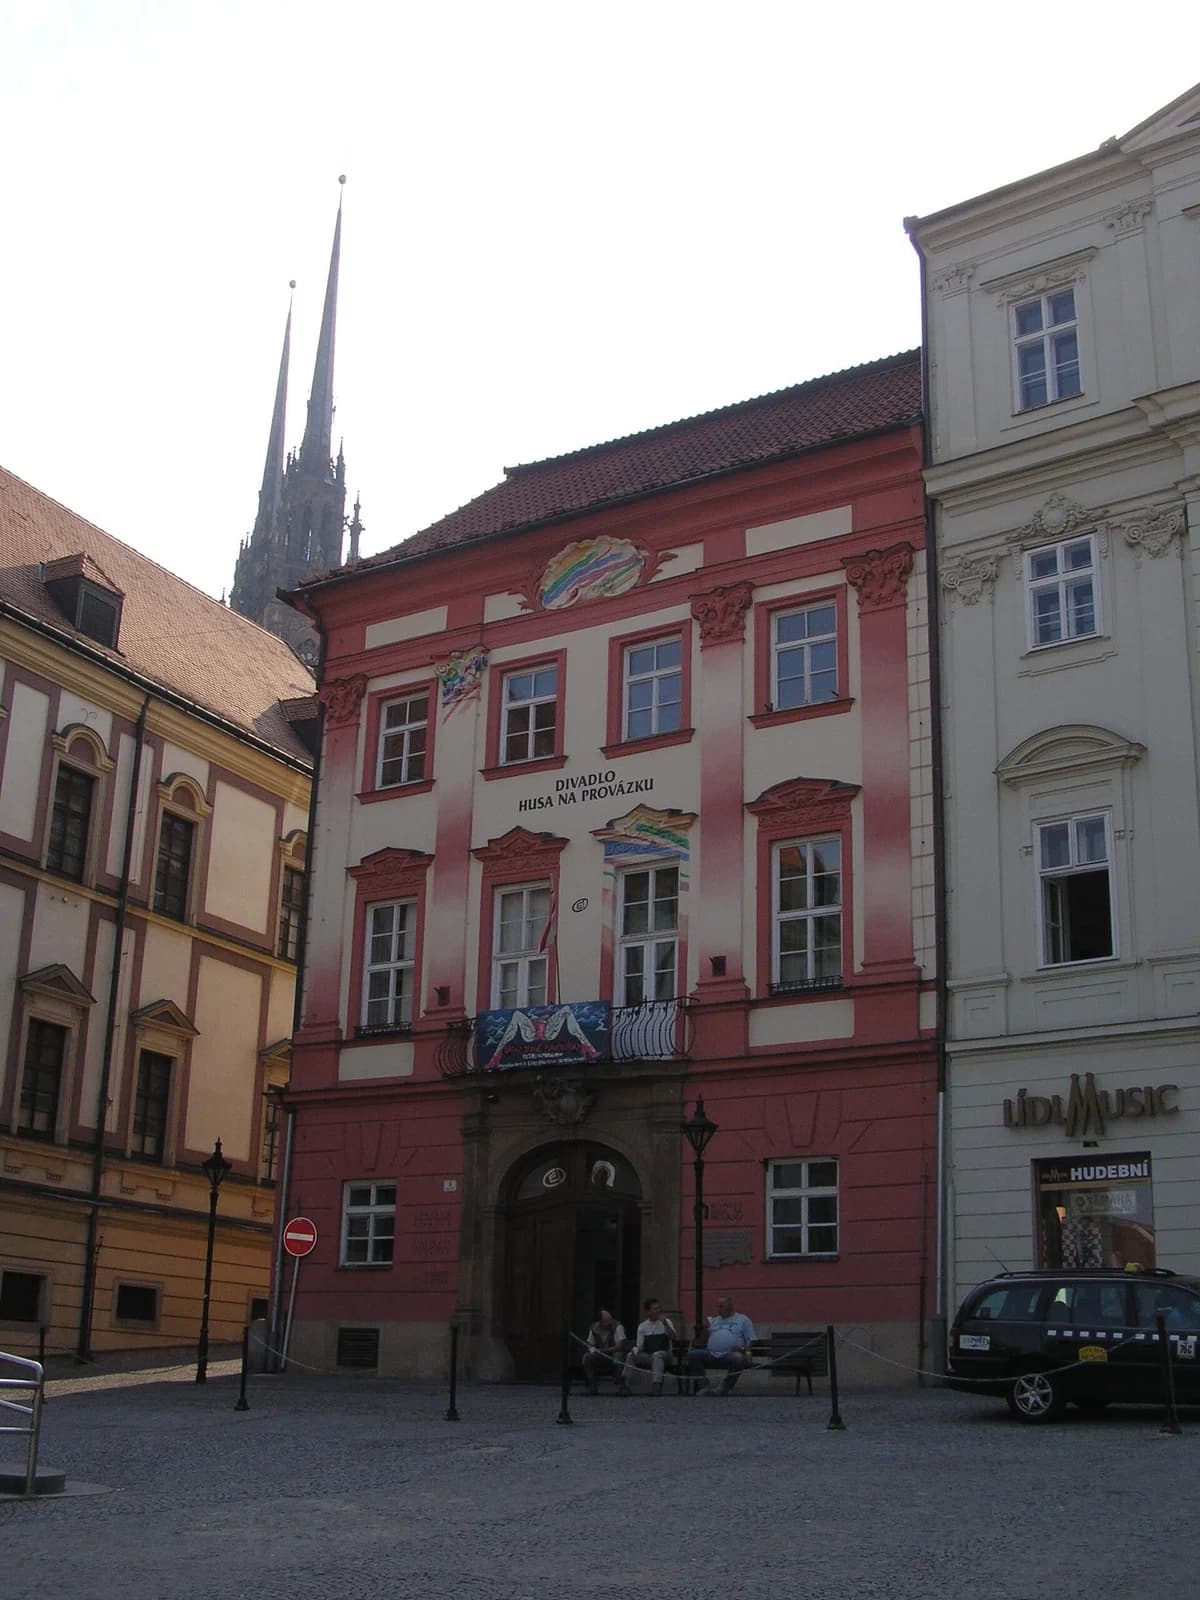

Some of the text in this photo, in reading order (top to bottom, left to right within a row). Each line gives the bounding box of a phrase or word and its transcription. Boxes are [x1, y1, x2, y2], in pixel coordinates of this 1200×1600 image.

[555, 770, 616, 792] DIVADLO
[518, 778, 654, 812] HUSA NA PROVÁZKU
[1070, 1160, 1148, 1181] HUDEBNÍ
